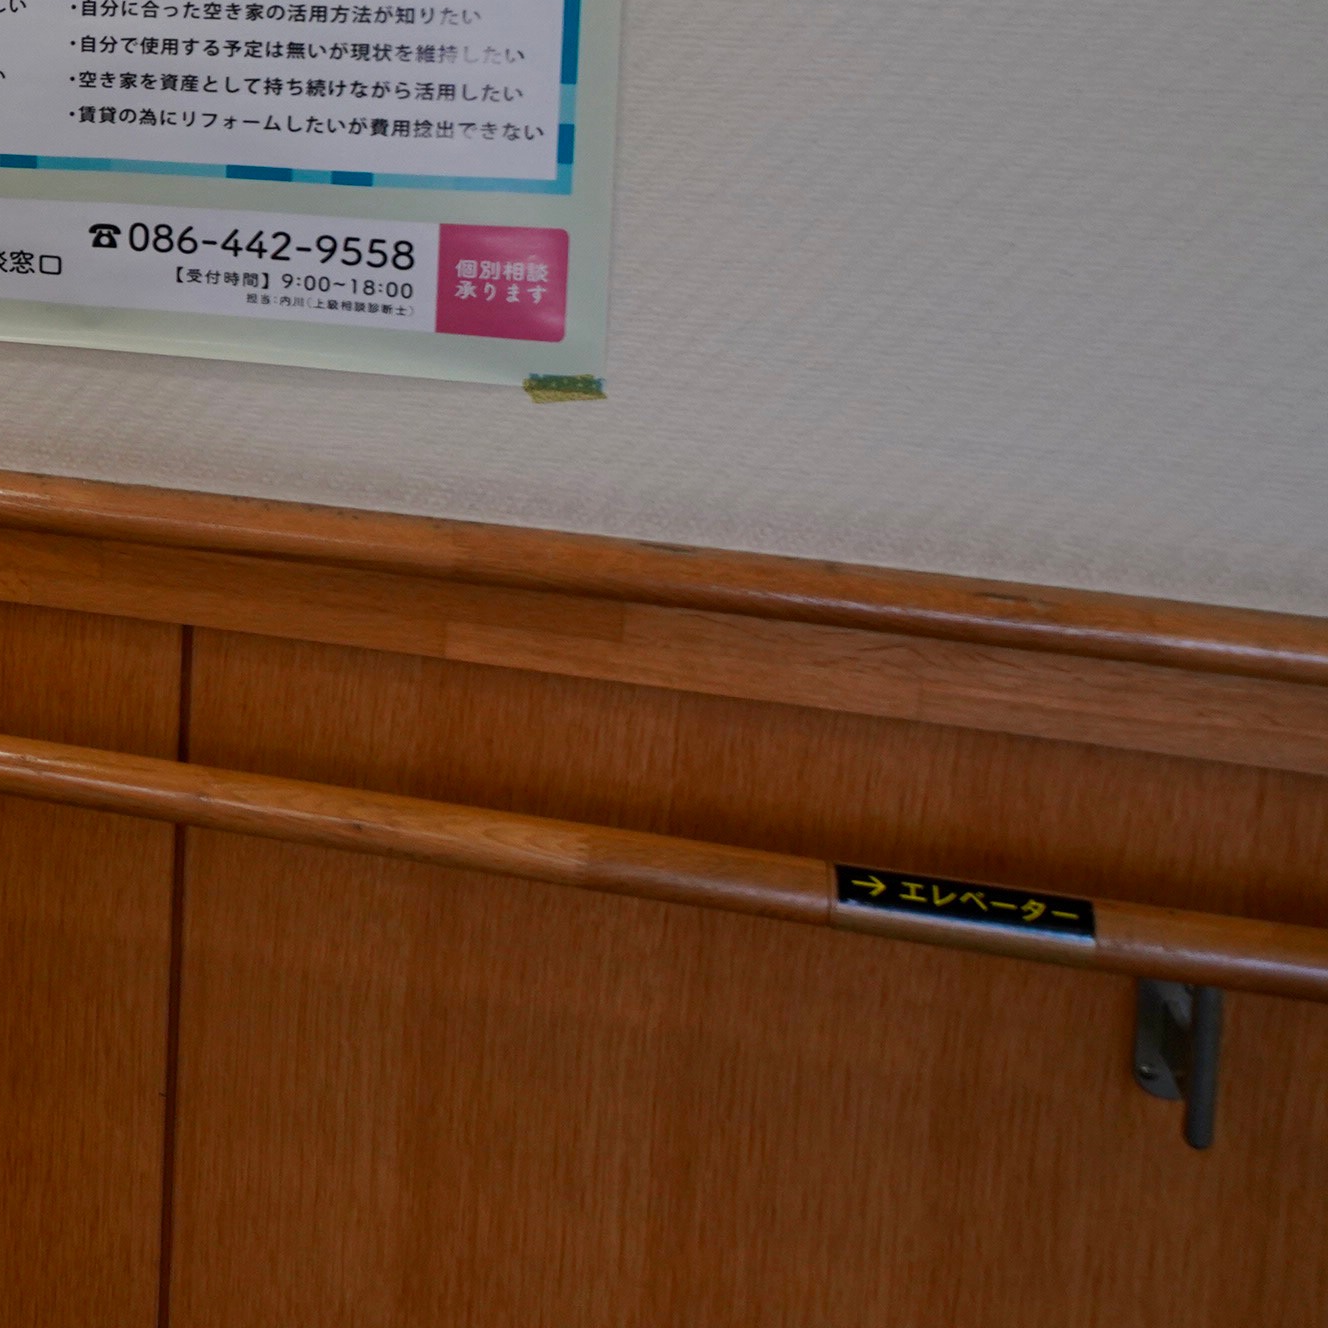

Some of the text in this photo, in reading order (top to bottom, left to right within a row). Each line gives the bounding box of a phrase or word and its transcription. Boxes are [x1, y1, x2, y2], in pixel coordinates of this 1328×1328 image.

[128, 221, 416, 271] 086-442-9558
[454, 259, 549, 282] 個別相談
[454, 280, 548, 304] 承ります
[898, 880, 1080, 922] エレベーター
